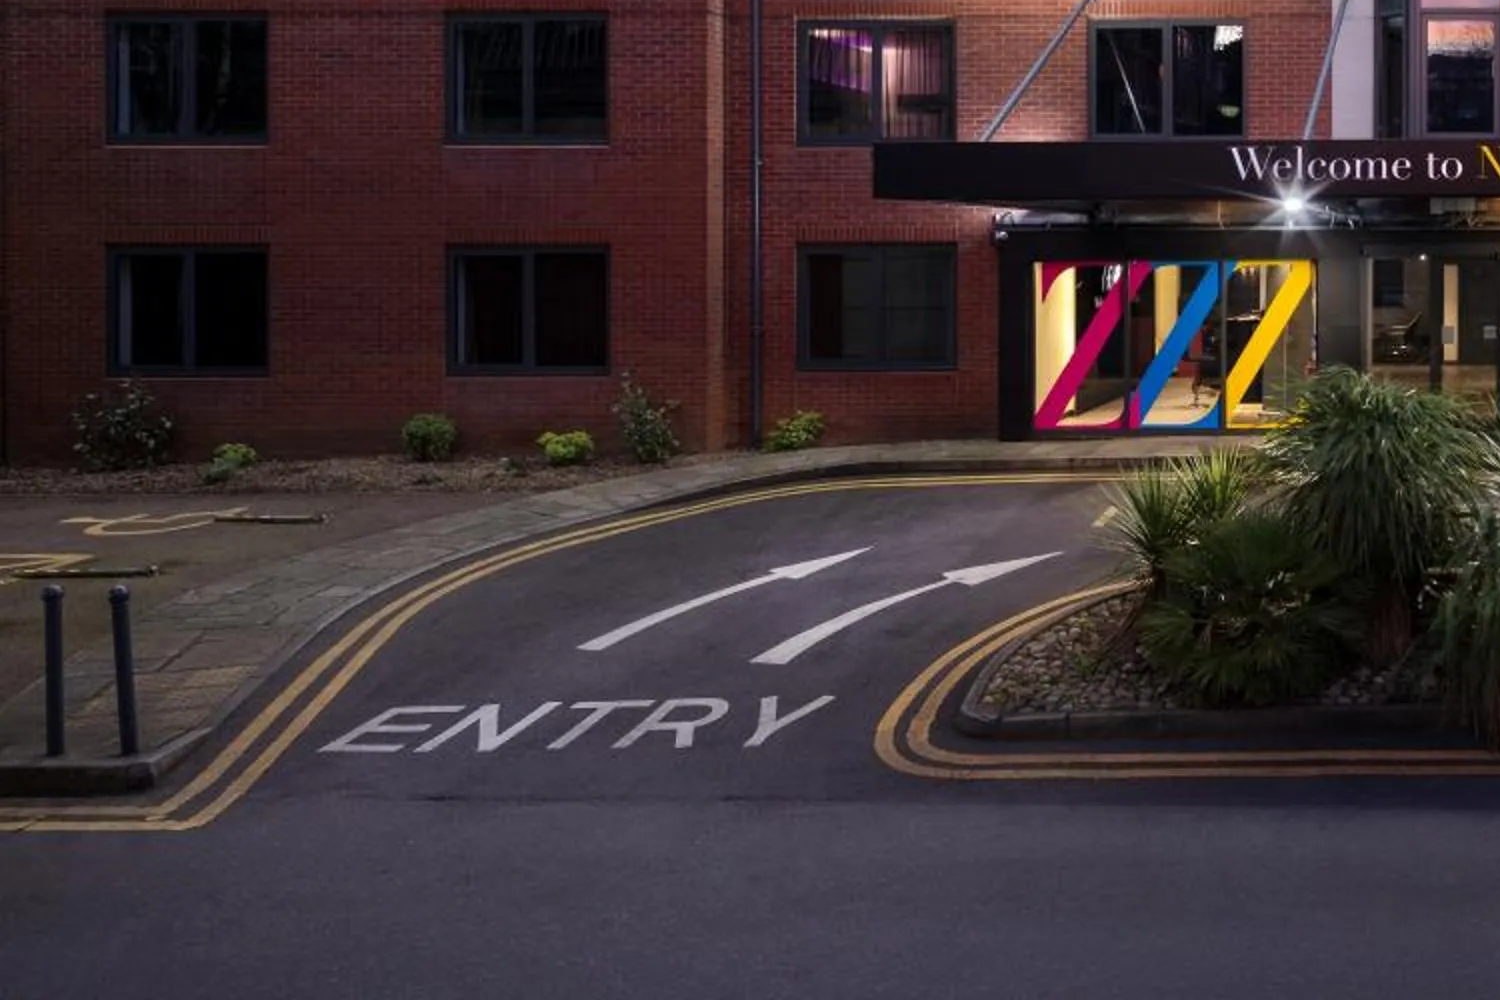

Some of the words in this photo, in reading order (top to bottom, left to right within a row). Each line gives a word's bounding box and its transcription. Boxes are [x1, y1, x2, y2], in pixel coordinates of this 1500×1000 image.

[1228, 145, 1411, 181] Welcome
[1427, 152, 1463, 181] to
[316, 695, 836, 753] ENTRY
